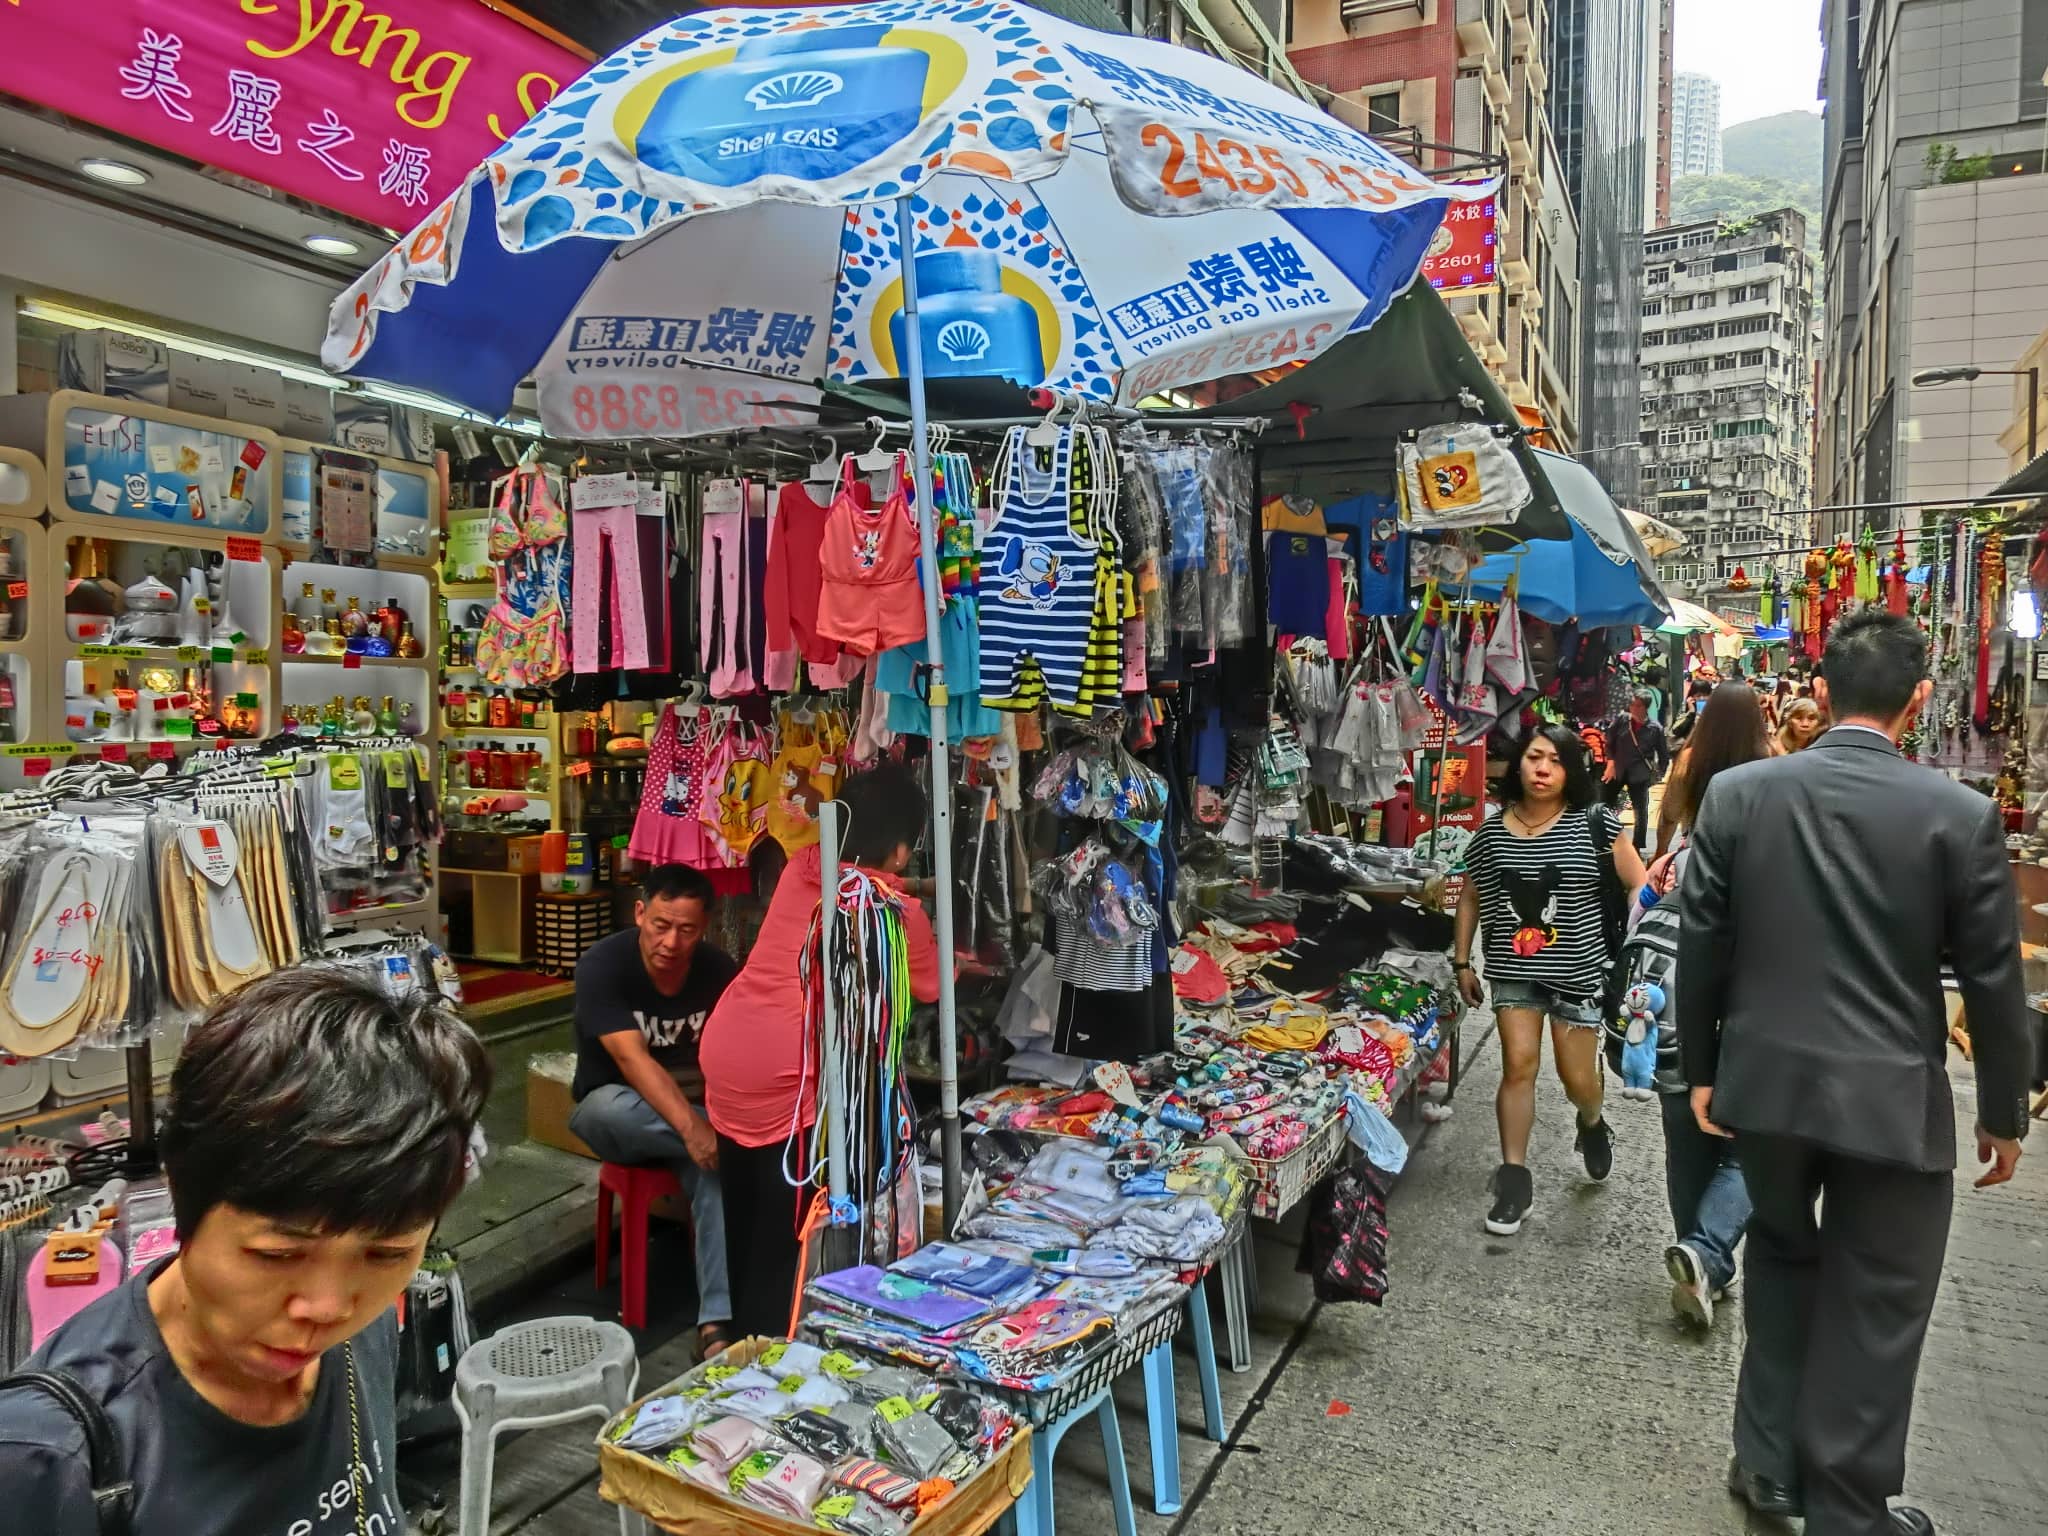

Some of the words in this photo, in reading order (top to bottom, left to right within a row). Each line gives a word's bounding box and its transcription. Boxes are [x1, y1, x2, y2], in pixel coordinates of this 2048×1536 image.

[240, 0, 472, 129] ying
[119, 27, 431, 207] 美麗之源
[717, 131, 776, 156] Shell
[782, 127, 839, 147] GAS
[1111, 85, 1200, 118] Shell
[1208, 110, 1264, 136] Gas
[1278, 131, 1406, 179] Delivery
[1140, 123, 1310, 198] 2435
[1441, 205, 1481, 223] 水餃
[1440, 253, 1481, 269] 2601
[84, 416, 144, 452] ELISE
